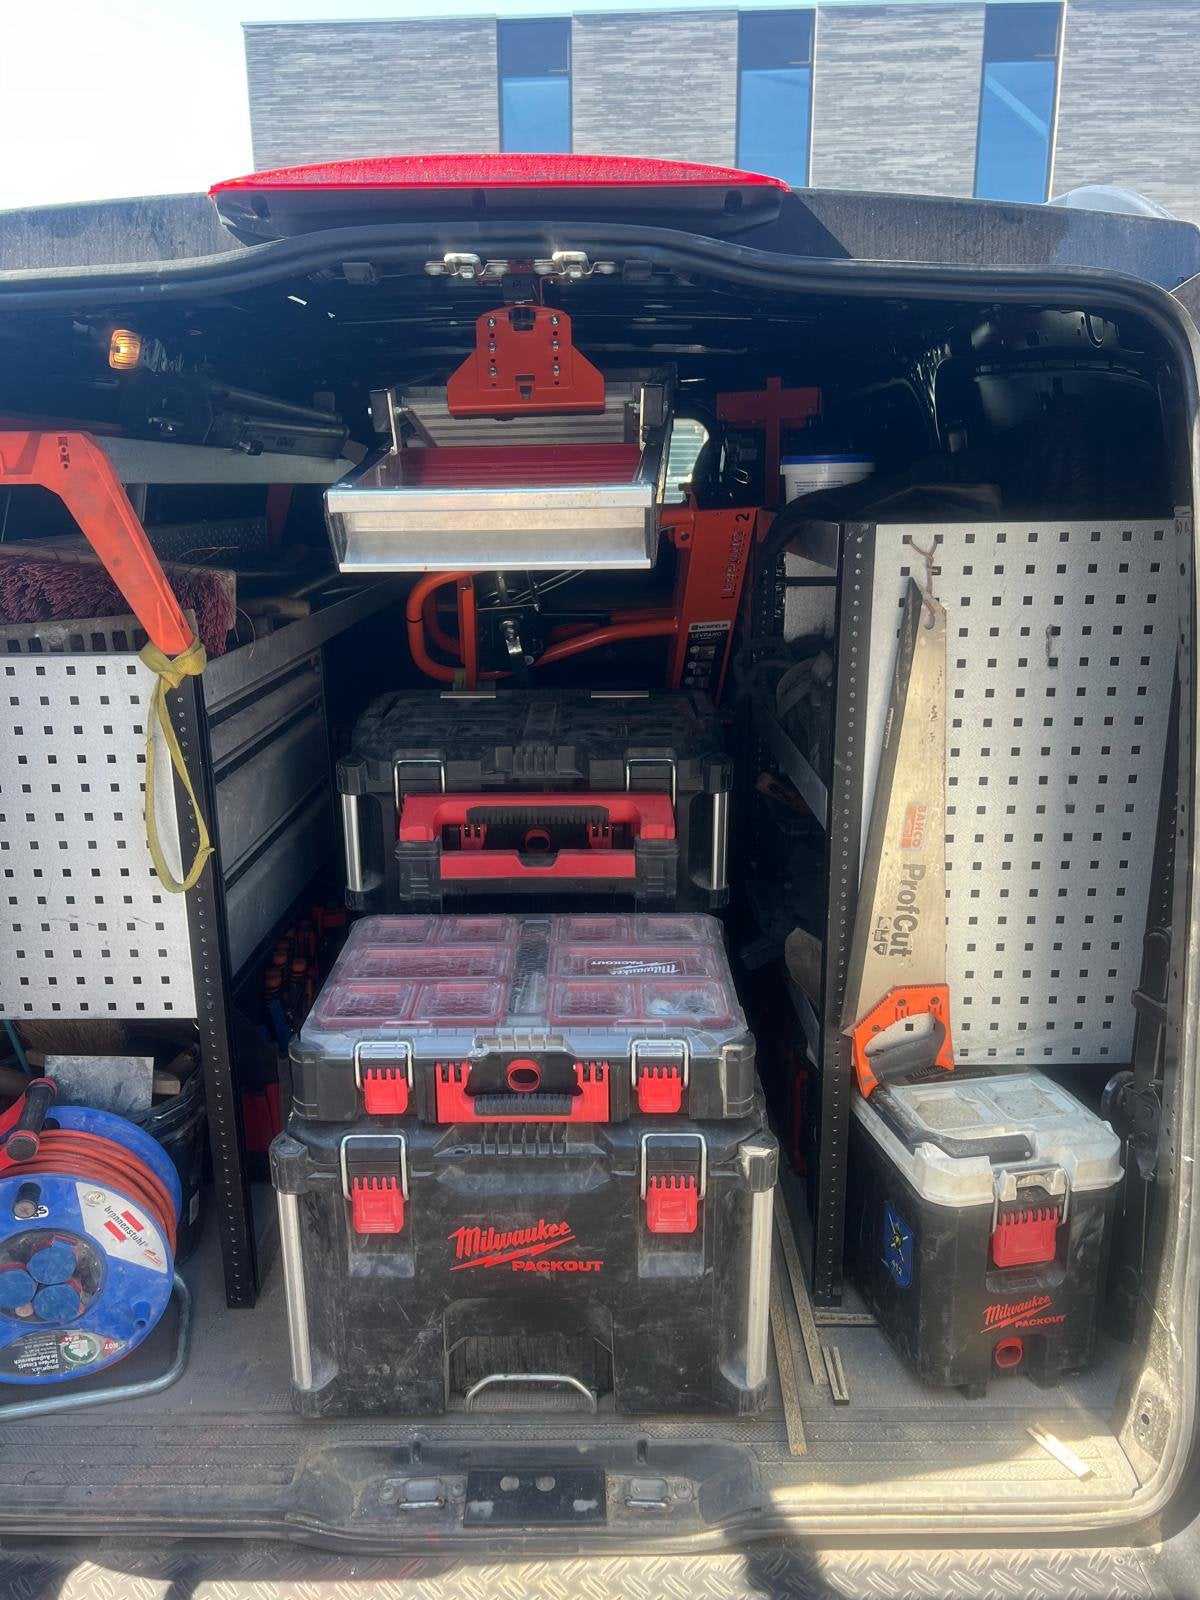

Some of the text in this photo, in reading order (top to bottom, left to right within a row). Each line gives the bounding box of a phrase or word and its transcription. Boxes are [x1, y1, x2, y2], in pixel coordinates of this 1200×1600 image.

[735, 512, 750, 522] 2
[889, 864, 926, 957] ProfCut
[610, 964, 680, 976] Milwaukee
[104, 1205, 146, 1246] brennenstuhl
[448, 1219, 572, 1258] Milwaukee
[511, 1260, 604, 1272] PACKOUT
[982, 1295, 1051, 1326] Milwaukee
[1015, 1314, 1066, 1328] PACKOUT
